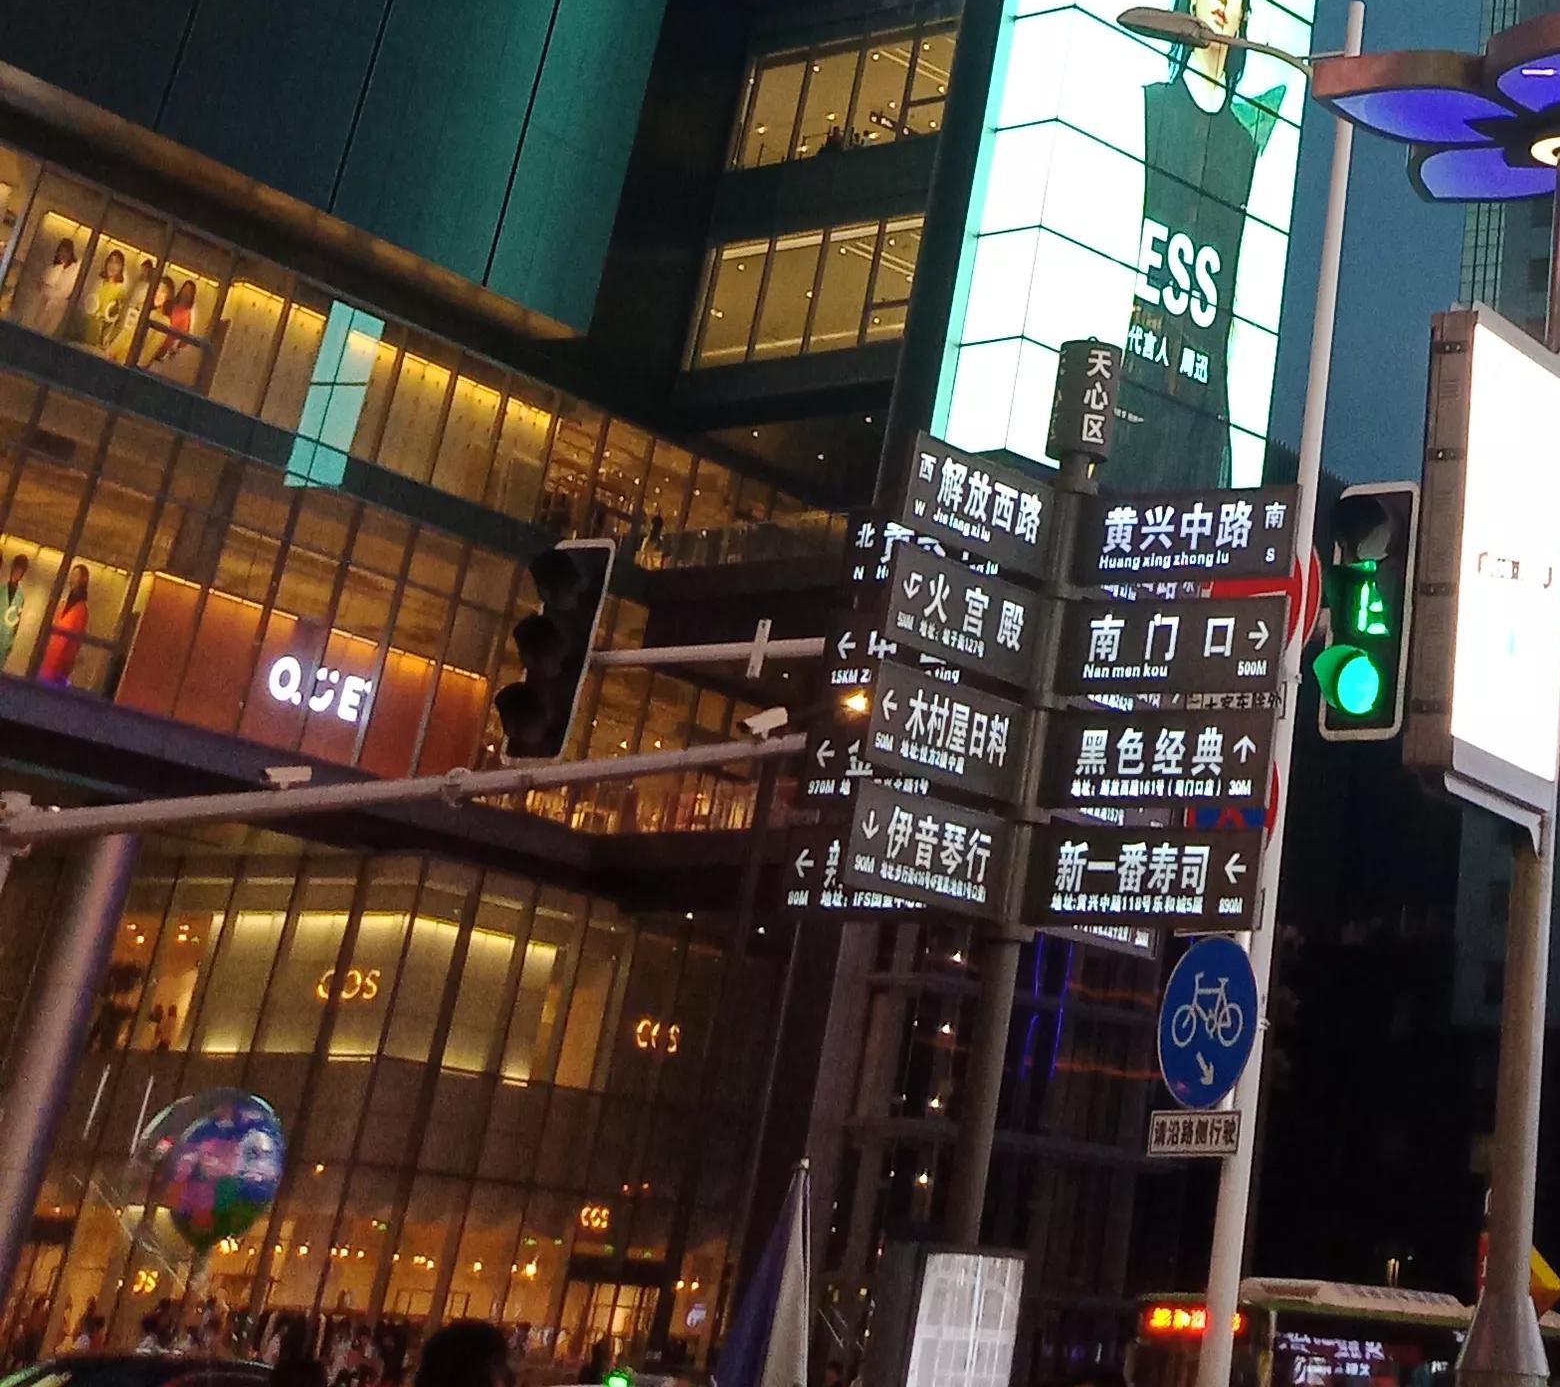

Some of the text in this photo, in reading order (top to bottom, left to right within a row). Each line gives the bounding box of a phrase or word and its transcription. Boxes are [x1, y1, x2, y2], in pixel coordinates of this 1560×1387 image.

[1134, 217, 1221, 328] ESS
[1128, 325, 1170, 367] 代言人
[1081, 349, 1113, 445] 天心区
[914, 499, 926, 516] W
[918, 452, 937, 484] 西
[937, 457, 1043, 544] 解放西路
[855, 522, 877, 548] 北
[1102, 500, 1287, 554] 黄兴中路 南
[853, 565, 865, 580] N
[1098, 547, 1276, 571] Huang xing zhong lu S
[923, 573, 1025, 651] 火宫殿
[1088, 612, 1236, 662] 南门口
[1083, 660, 1267, 678] Nan men kou 500M
[905, 688, 1009, 767] 木村屋日料
[1075, 727, 1224, 776] 黑色经典
[887, 806, 993, 883] 伊音琴行
[1055, 840, 1211, 894] 新一番寿司
